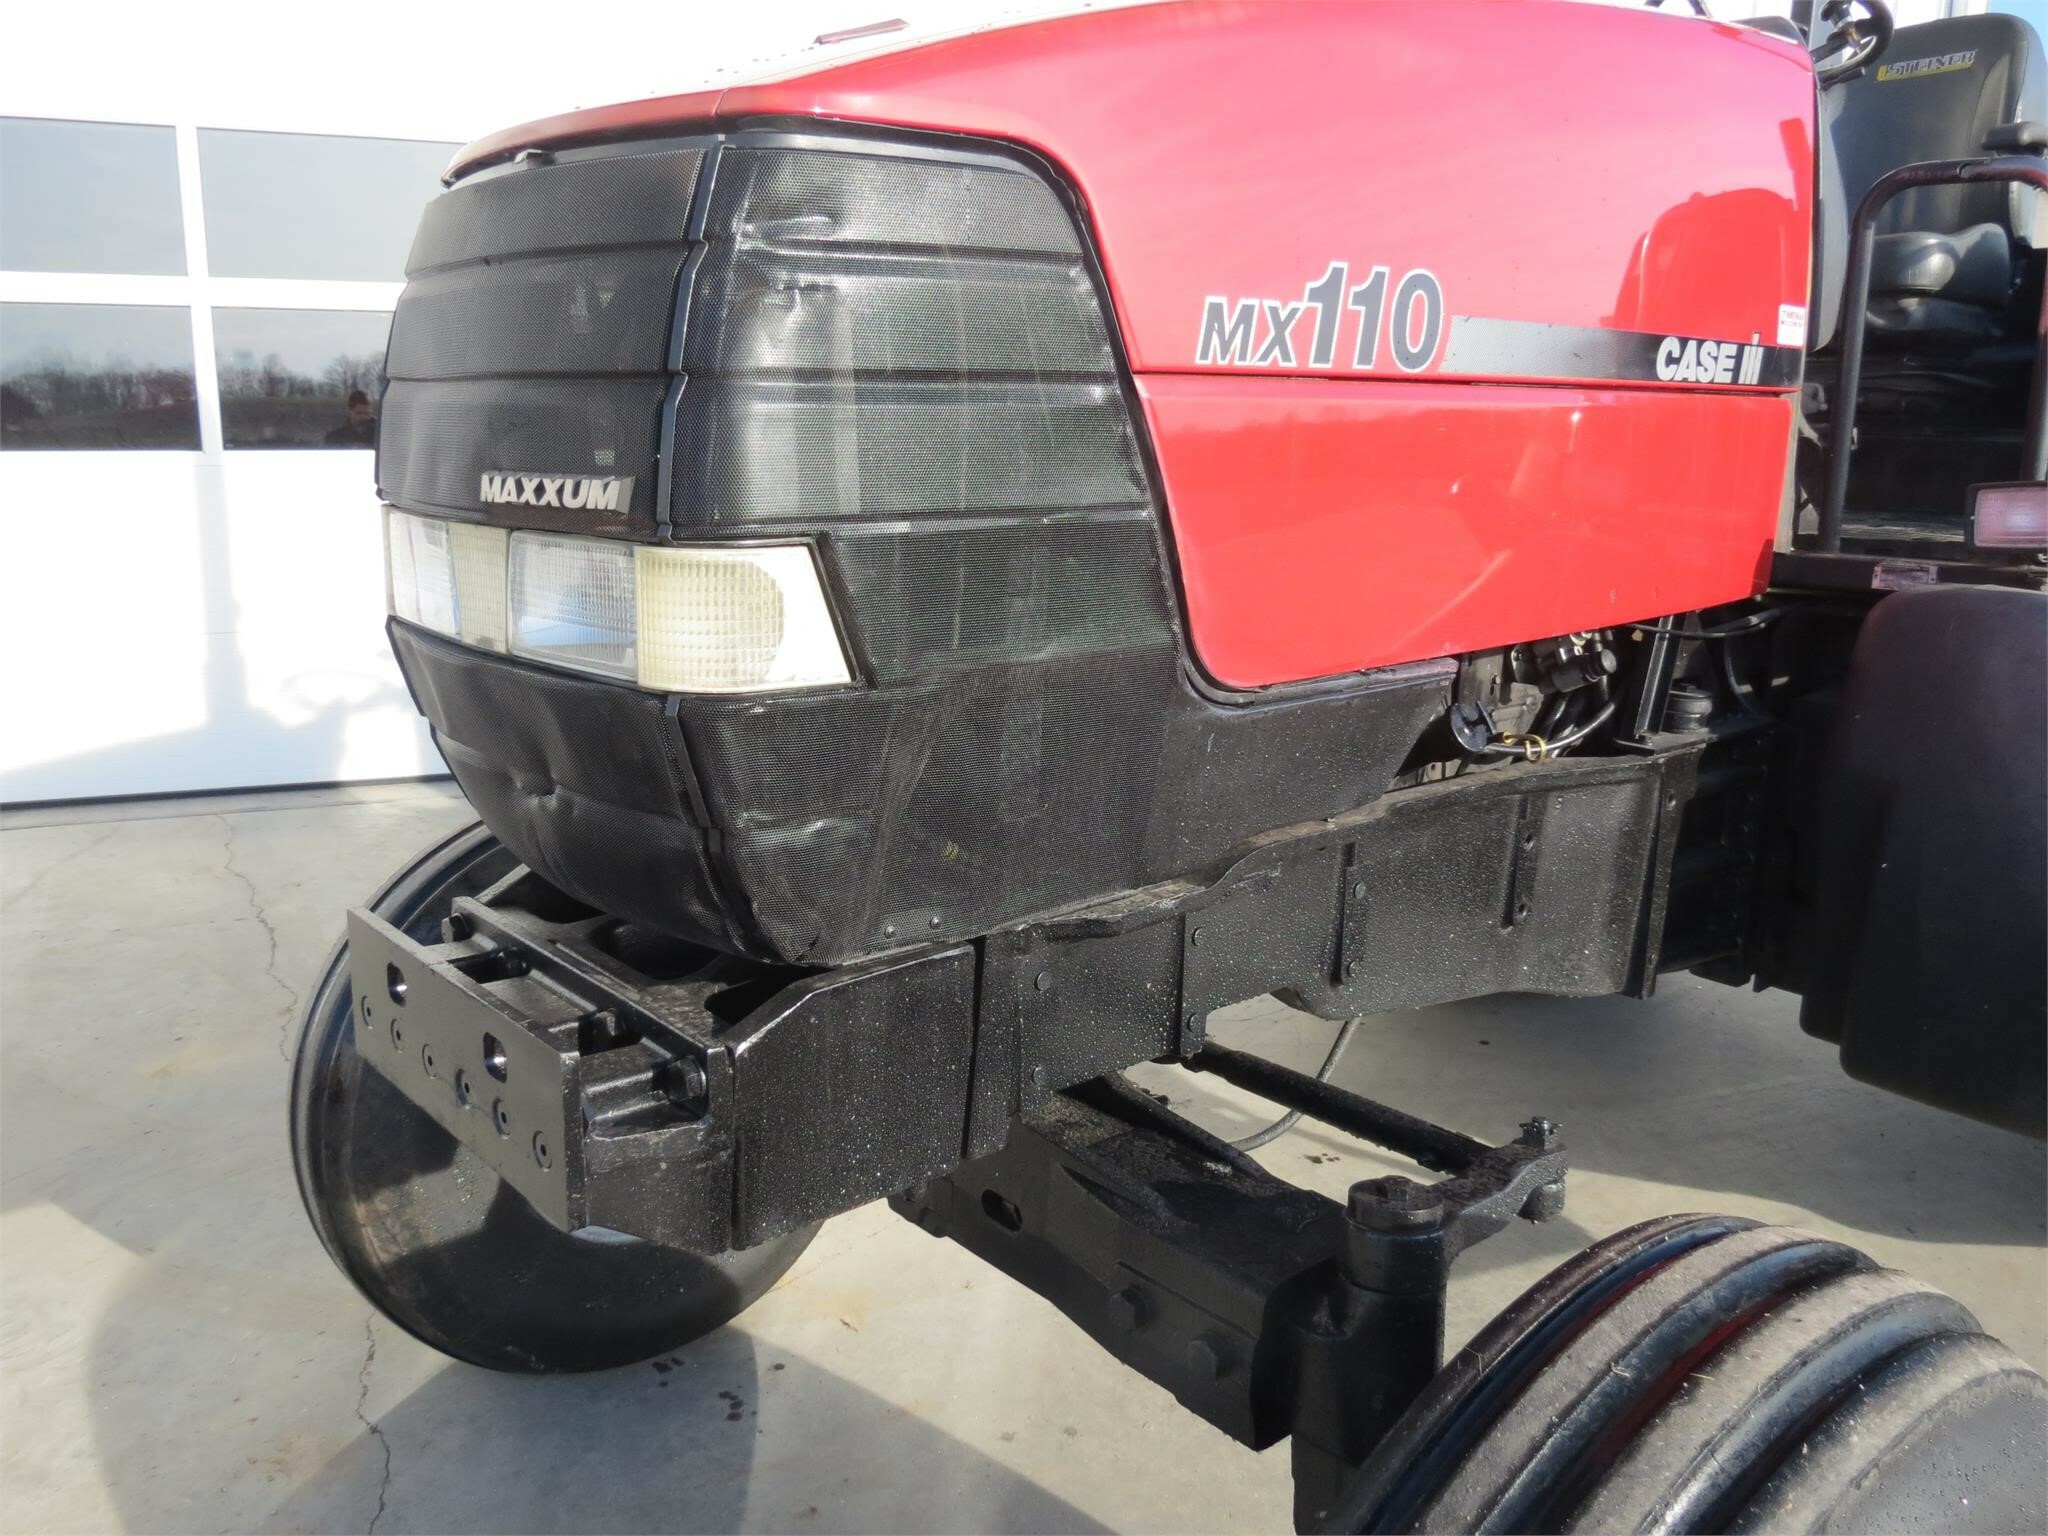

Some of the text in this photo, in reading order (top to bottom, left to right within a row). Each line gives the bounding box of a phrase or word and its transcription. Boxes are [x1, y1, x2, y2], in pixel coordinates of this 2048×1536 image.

[1195, 261, 1443, 373] MX110
[1656, 336, 1737, 384] CASE
[480, 474, 621, 510] MAXXUM
